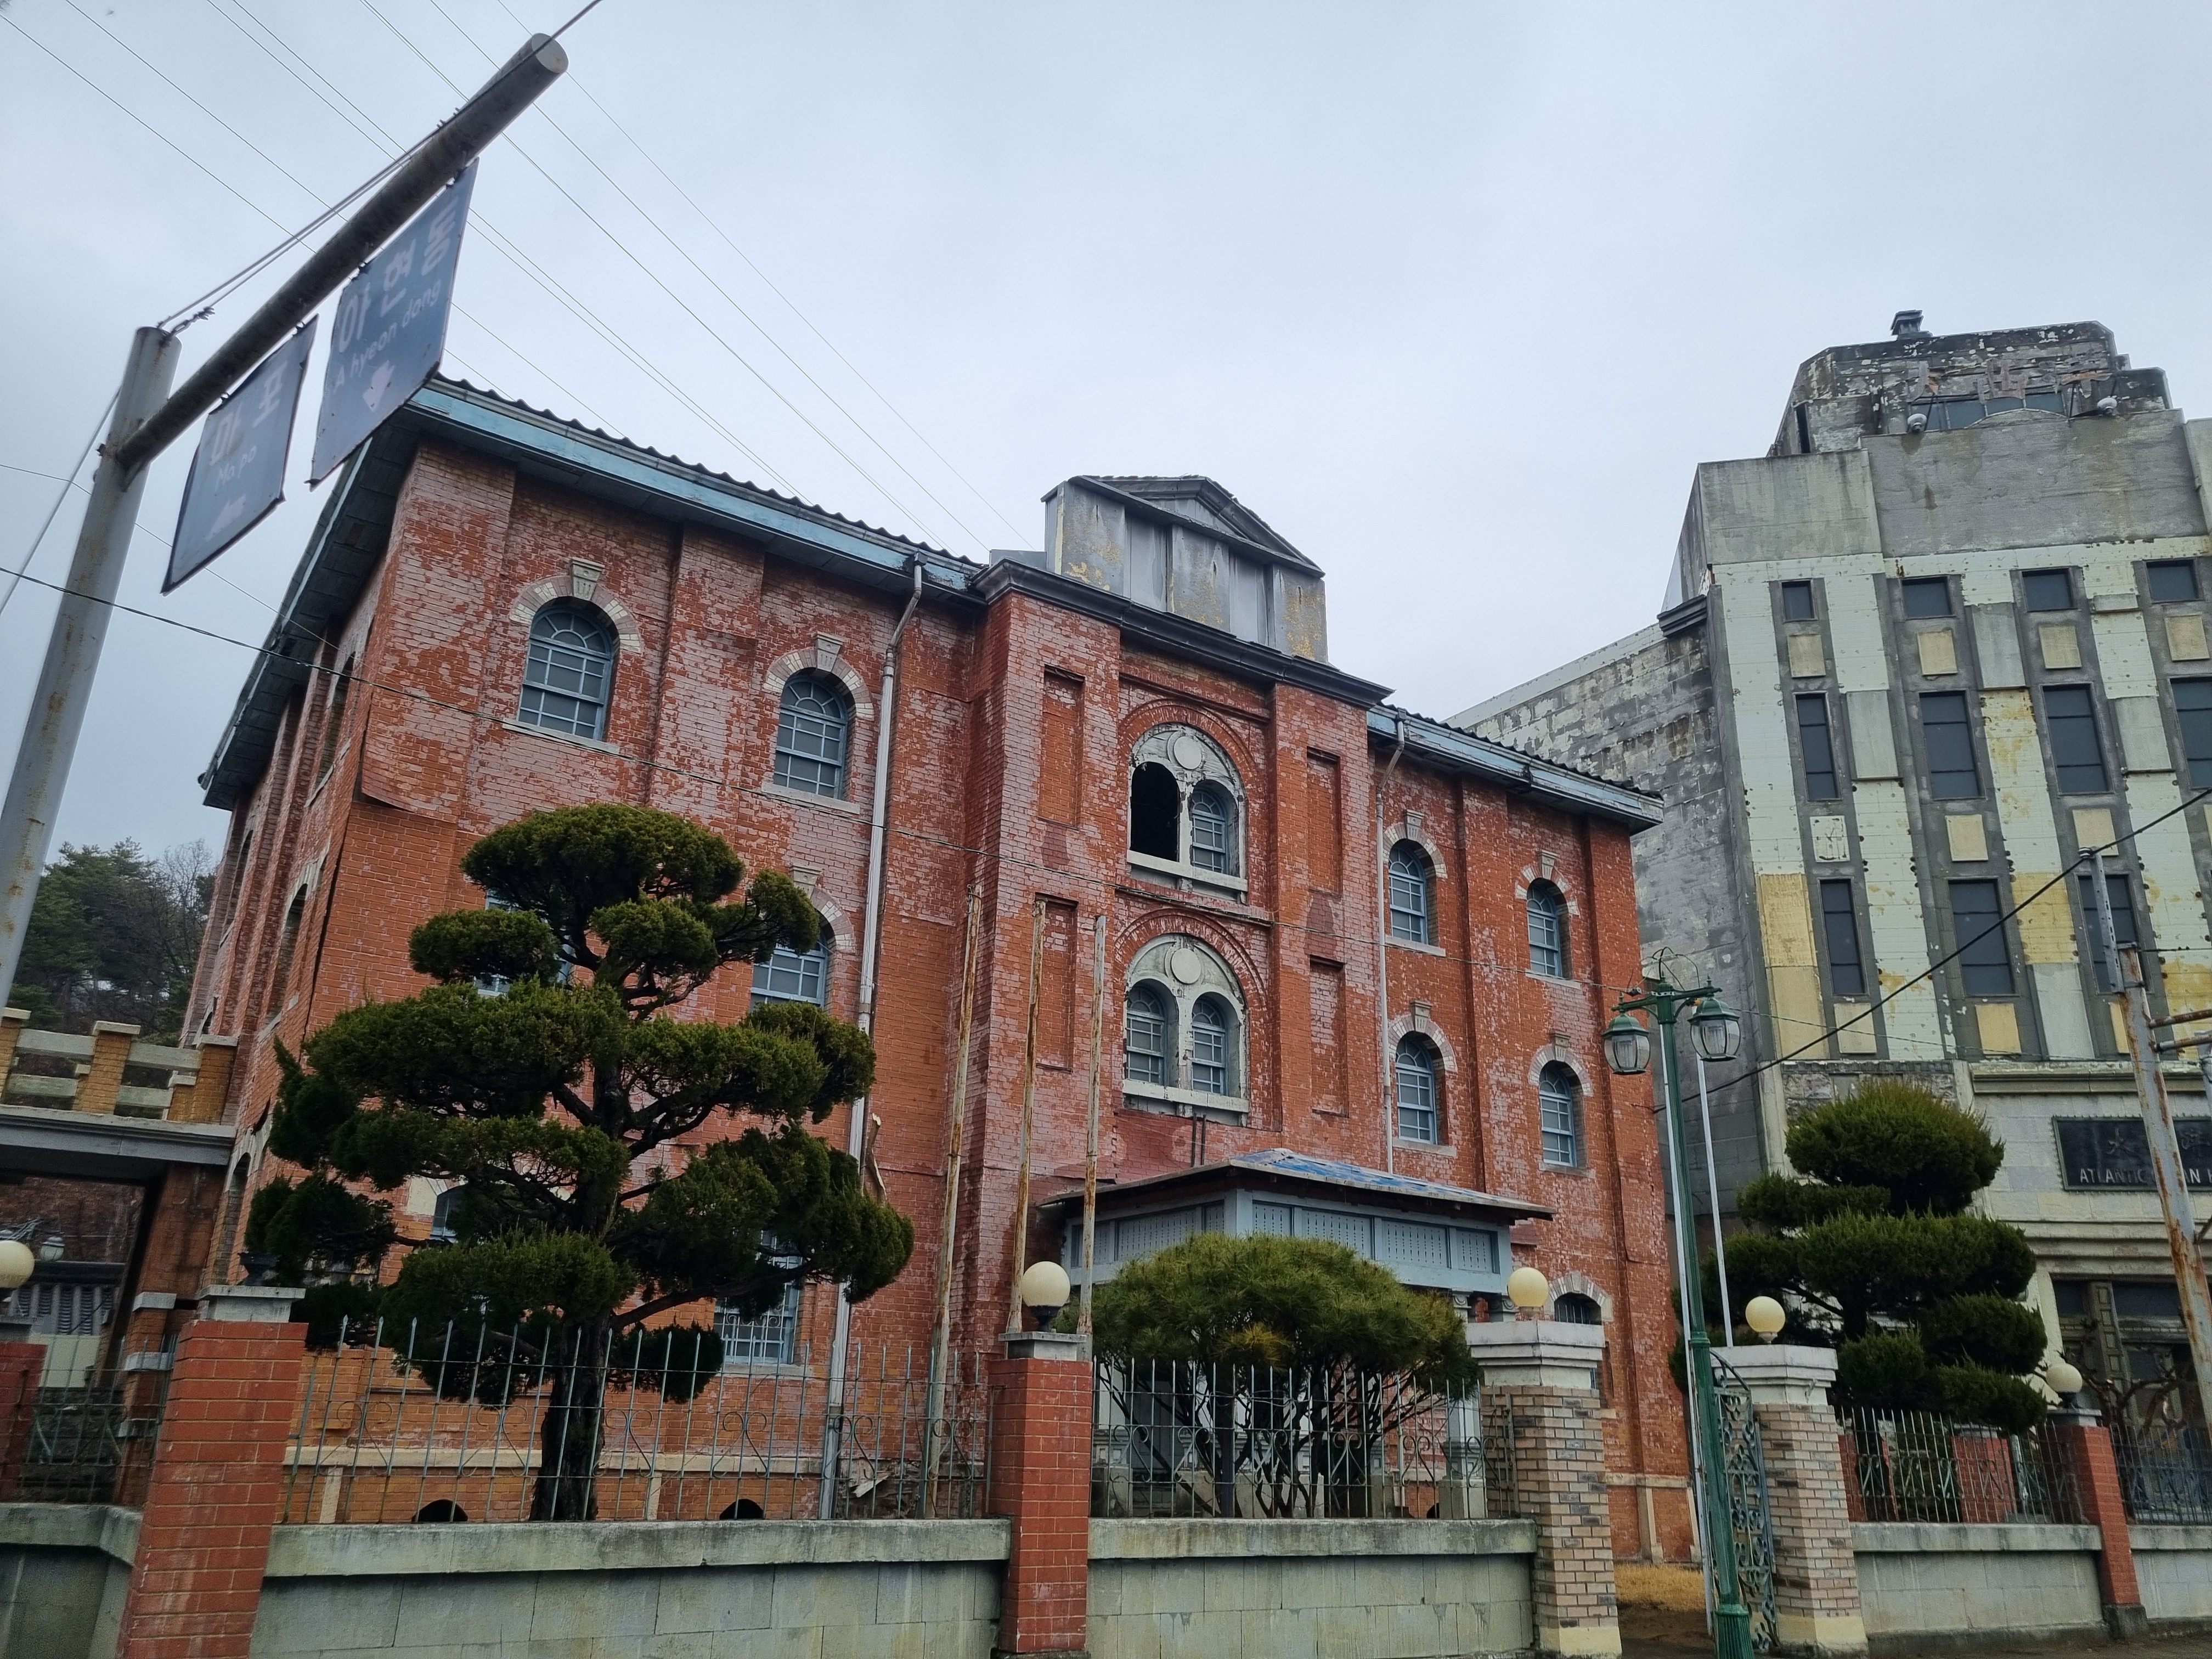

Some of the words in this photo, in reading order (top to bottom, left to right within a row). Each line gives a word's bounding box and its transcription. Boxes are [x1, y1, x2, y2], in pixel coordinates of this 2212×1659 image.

[339, 196, 459, 353] 아현동
[334, 365, 345, 394] A
[350, 321, 397, 379] hyeon
[402, 278, 441, 328] dong
[210, 360, 287, 466] 마포
[2080, 1168, 2147, 1183] ATLANTIC
